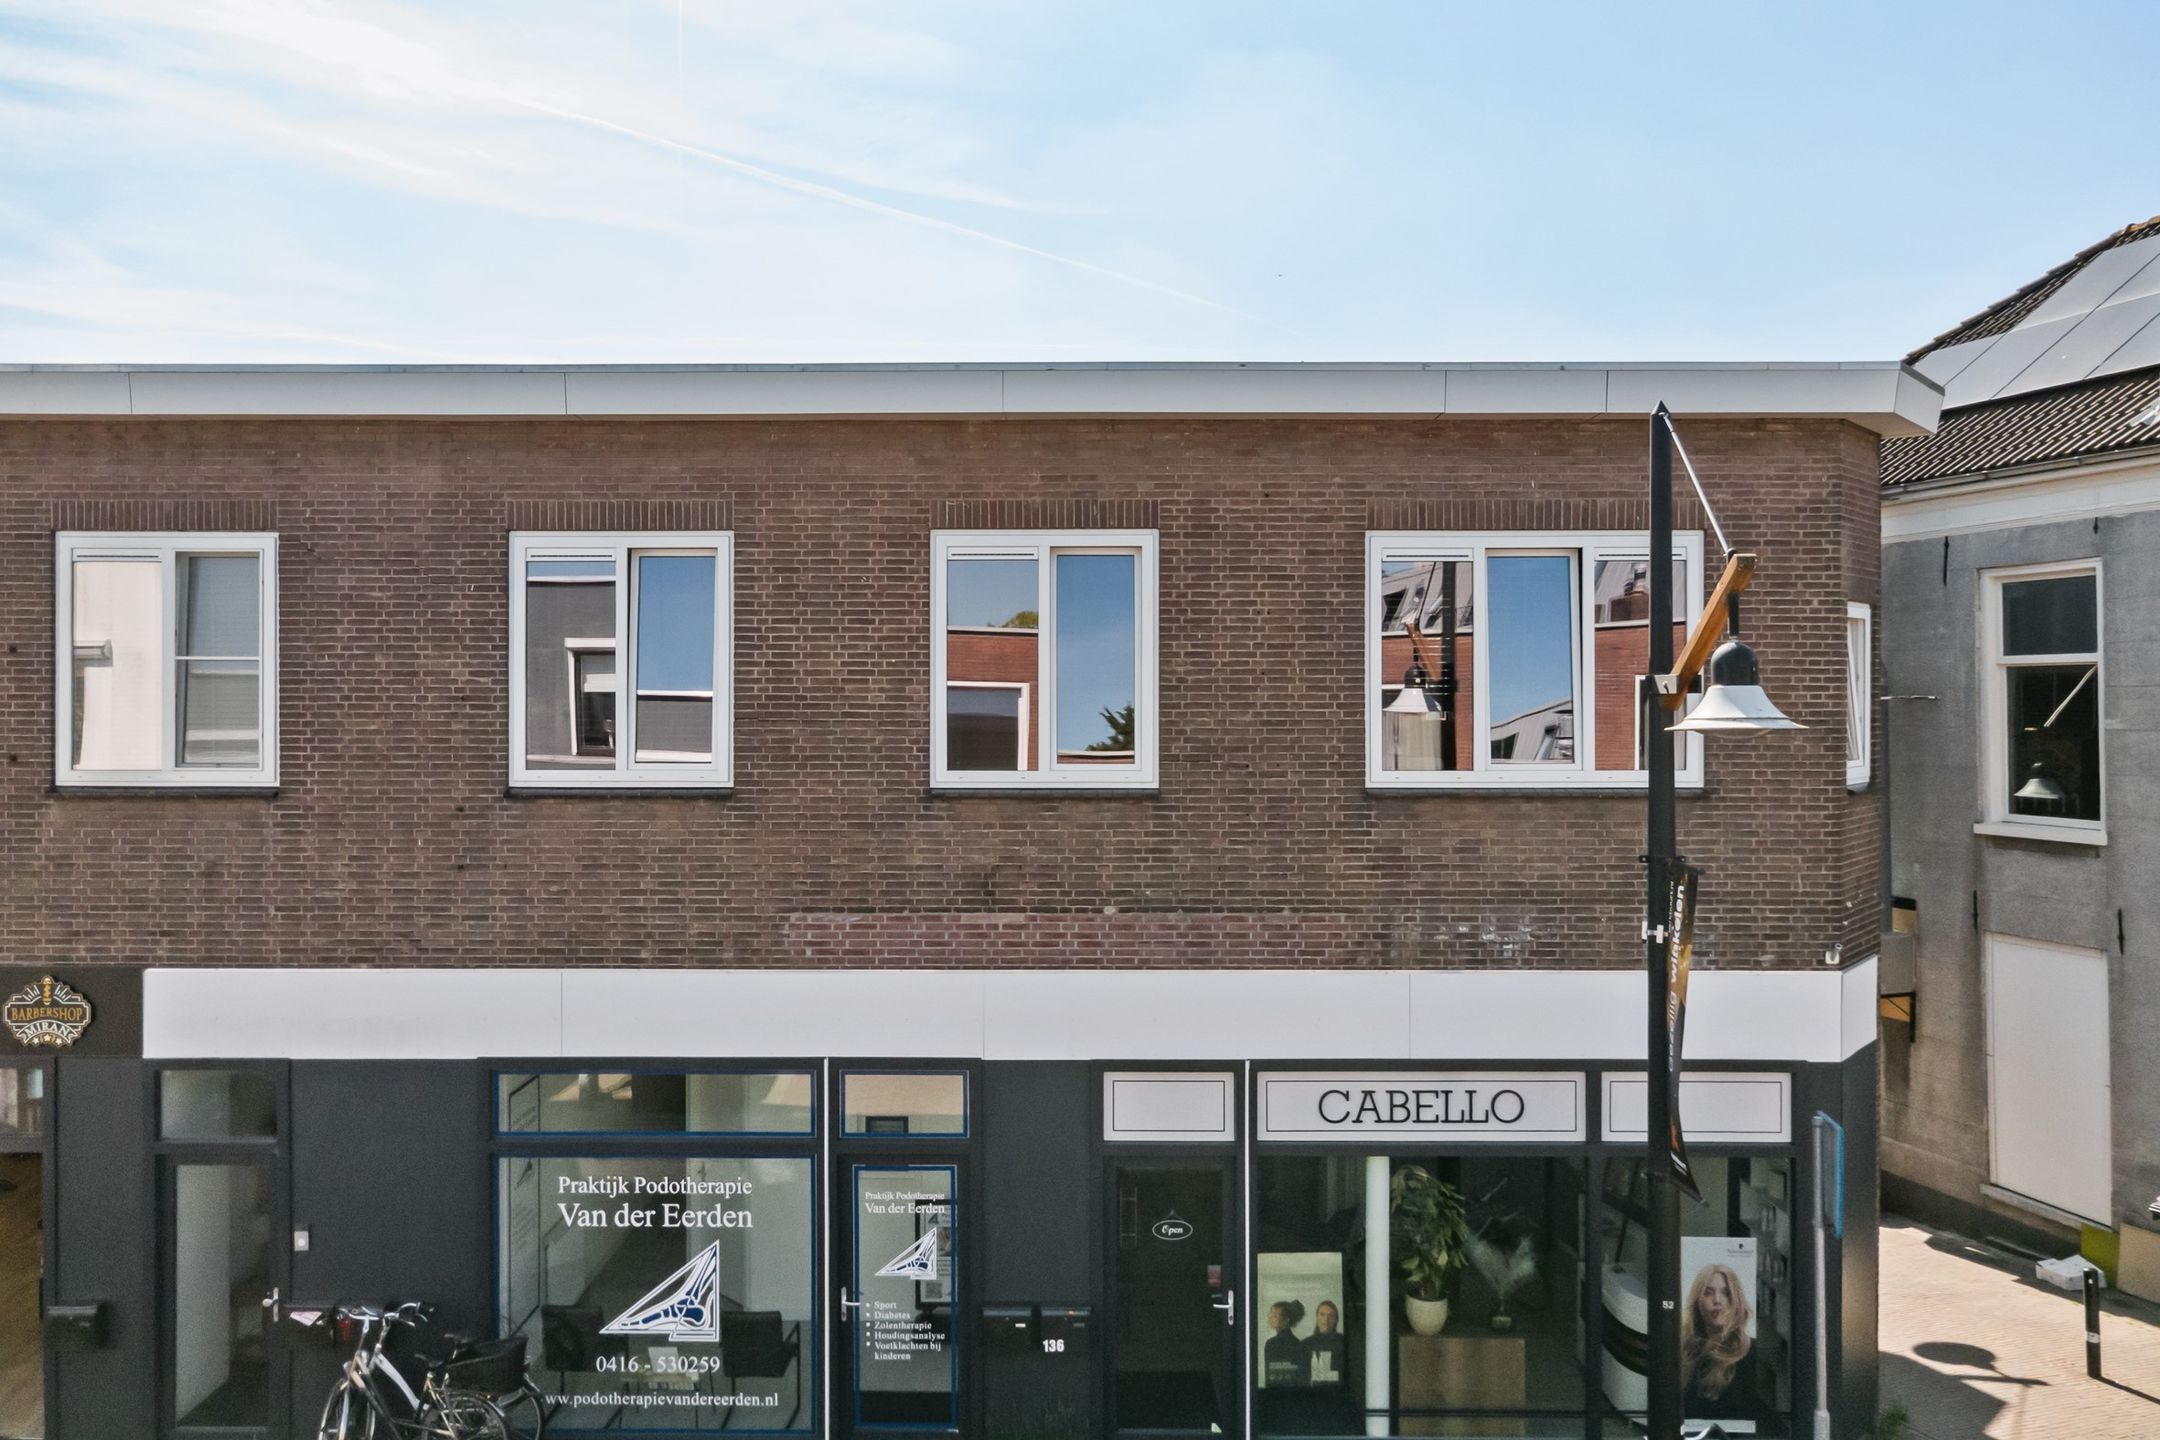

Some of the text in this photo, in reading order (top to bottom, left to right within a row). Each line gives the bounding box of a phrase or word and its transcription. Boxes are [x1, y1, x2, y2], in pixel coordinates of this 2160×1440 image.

[11, 1007, 83, 1021] BARBERSHOP
[24, 1021, 70, 1037] MIRAN
[1318, 1089, 1525, 1124] CABELLO
[558, 1175, 753, 1200] Praktijk Podotherapie
[865, 1191, 945, 1202] Praktijk Podotherapie
[865, 1202, 946, 1214] Van der Eerden
[557, 1202, 754, 1228] Van der Eerden
[1161, 1224, 1184, 1236] Open
[874, 1301, 897, 1311] Sport
[874, 1311, 911, 1320] Diabetes
[874, 1321, 932, 1331] Zolentherapie
[874, 1331, 946, 1342] Houdingsanalyse
[874, 1341, 942, 1352] Voetklachten bij
[1042, 1339, 1065, 1353] 136
[874, 1351, 911, 1360] kinderen
[595, 1355, 640, 1373] 0416
[656, 1355, 721, 1374] 530259
[541, 1392, 779, 1408] ww.podotherapievandereerden.nl
